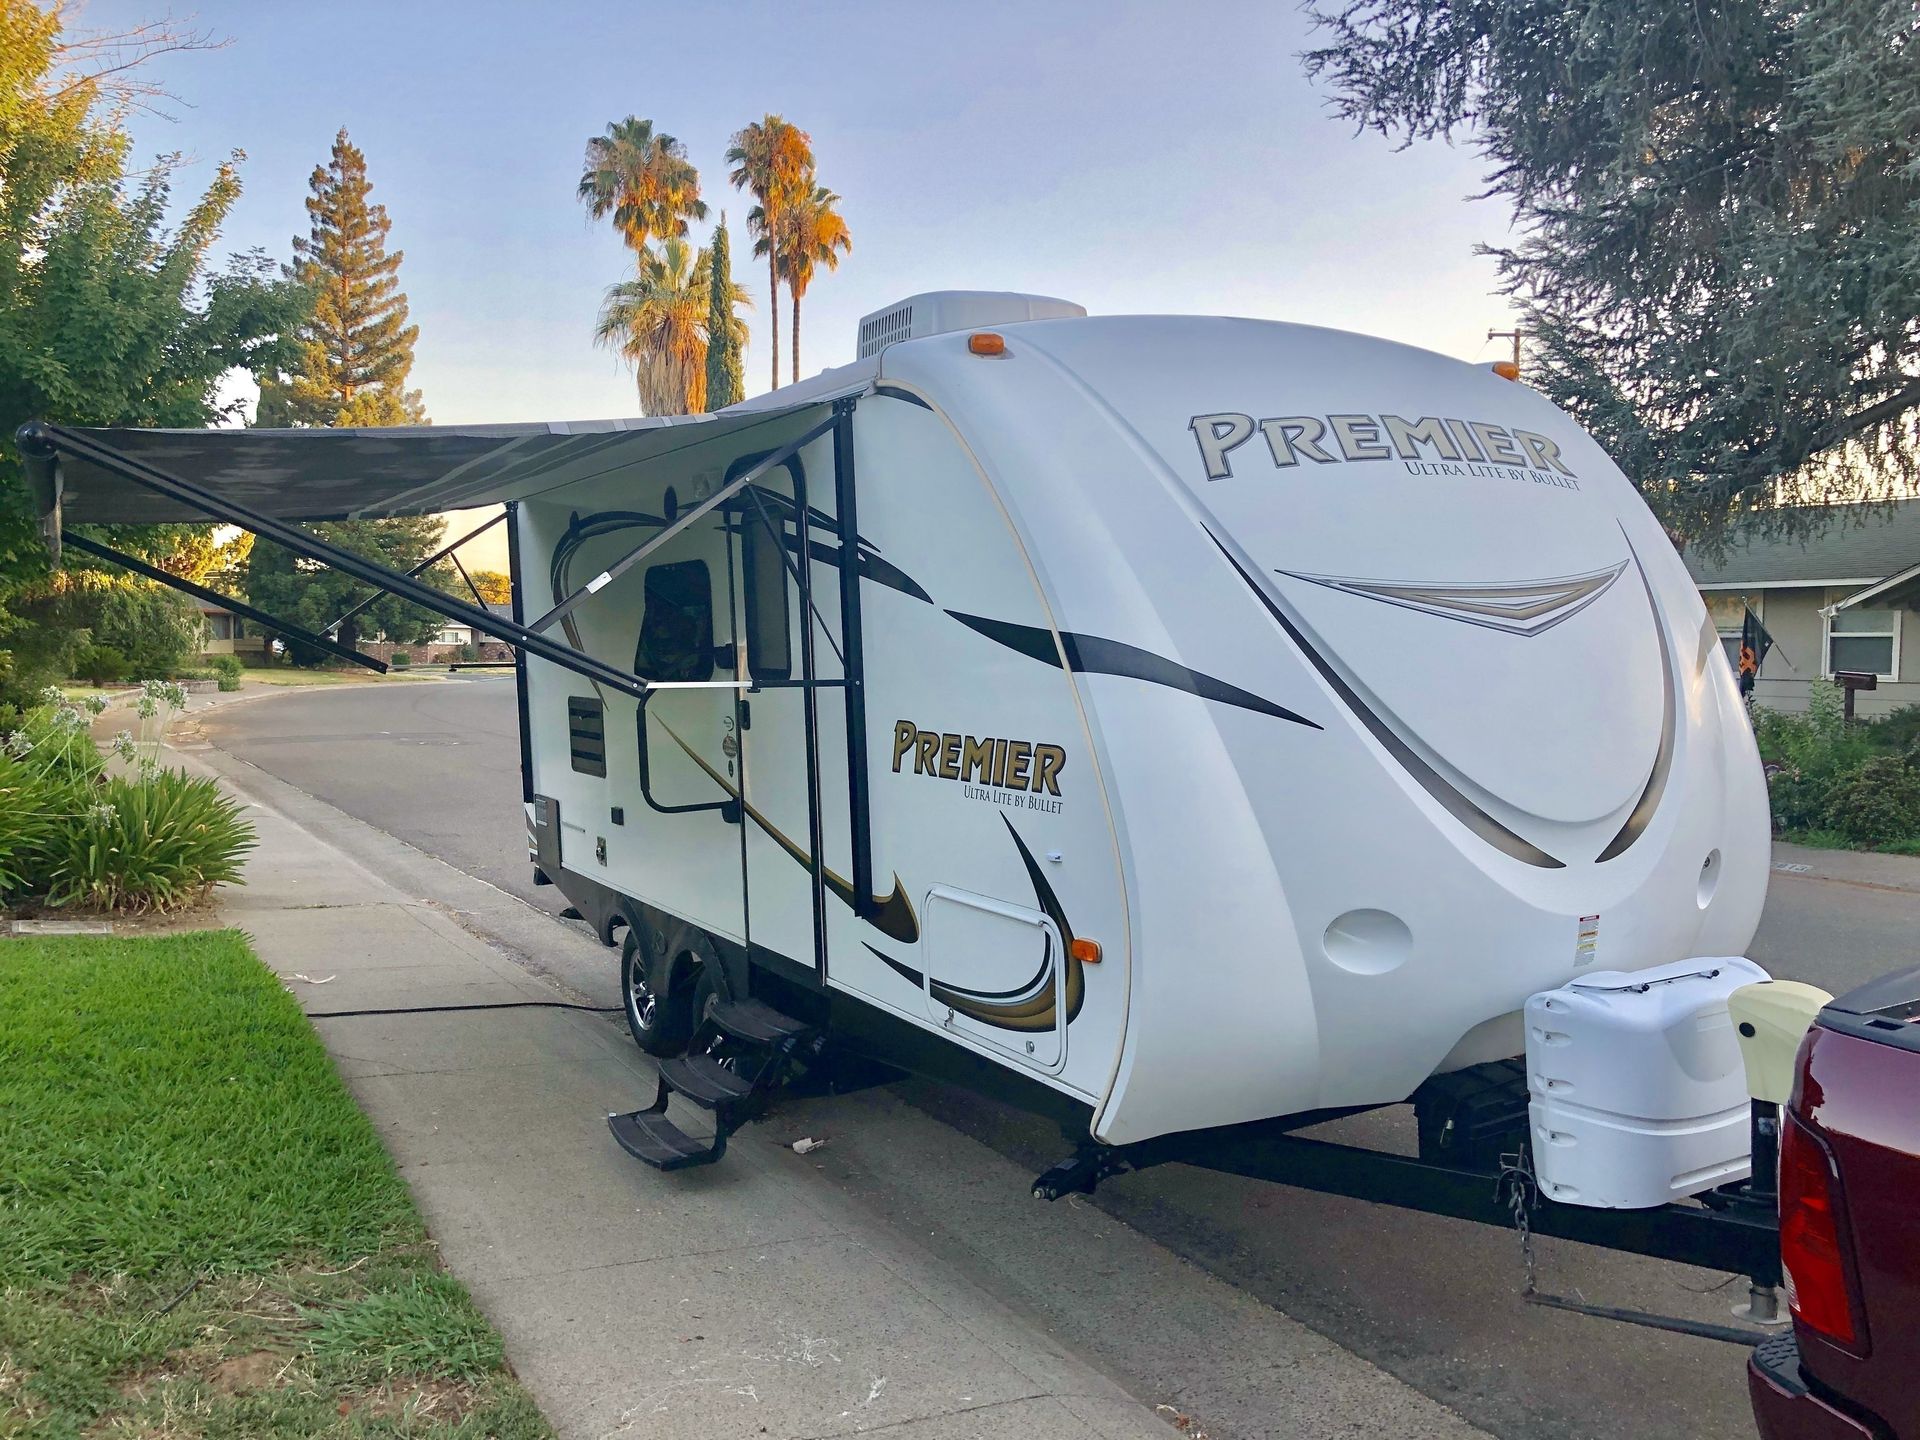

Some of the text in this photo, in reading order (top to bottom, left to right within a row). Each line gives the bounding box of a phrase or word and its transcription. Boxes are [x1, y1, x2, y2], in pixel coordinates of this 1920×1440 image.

[1189, 412, 1578, 482] PREMIER
[1404, 461, 1581, 492] ULTRA LITE BY BULLET
[892, 719, 1067, 797] PREMIER
[964, 784, 1064, 814] ULTRA LITE BY BULLET
